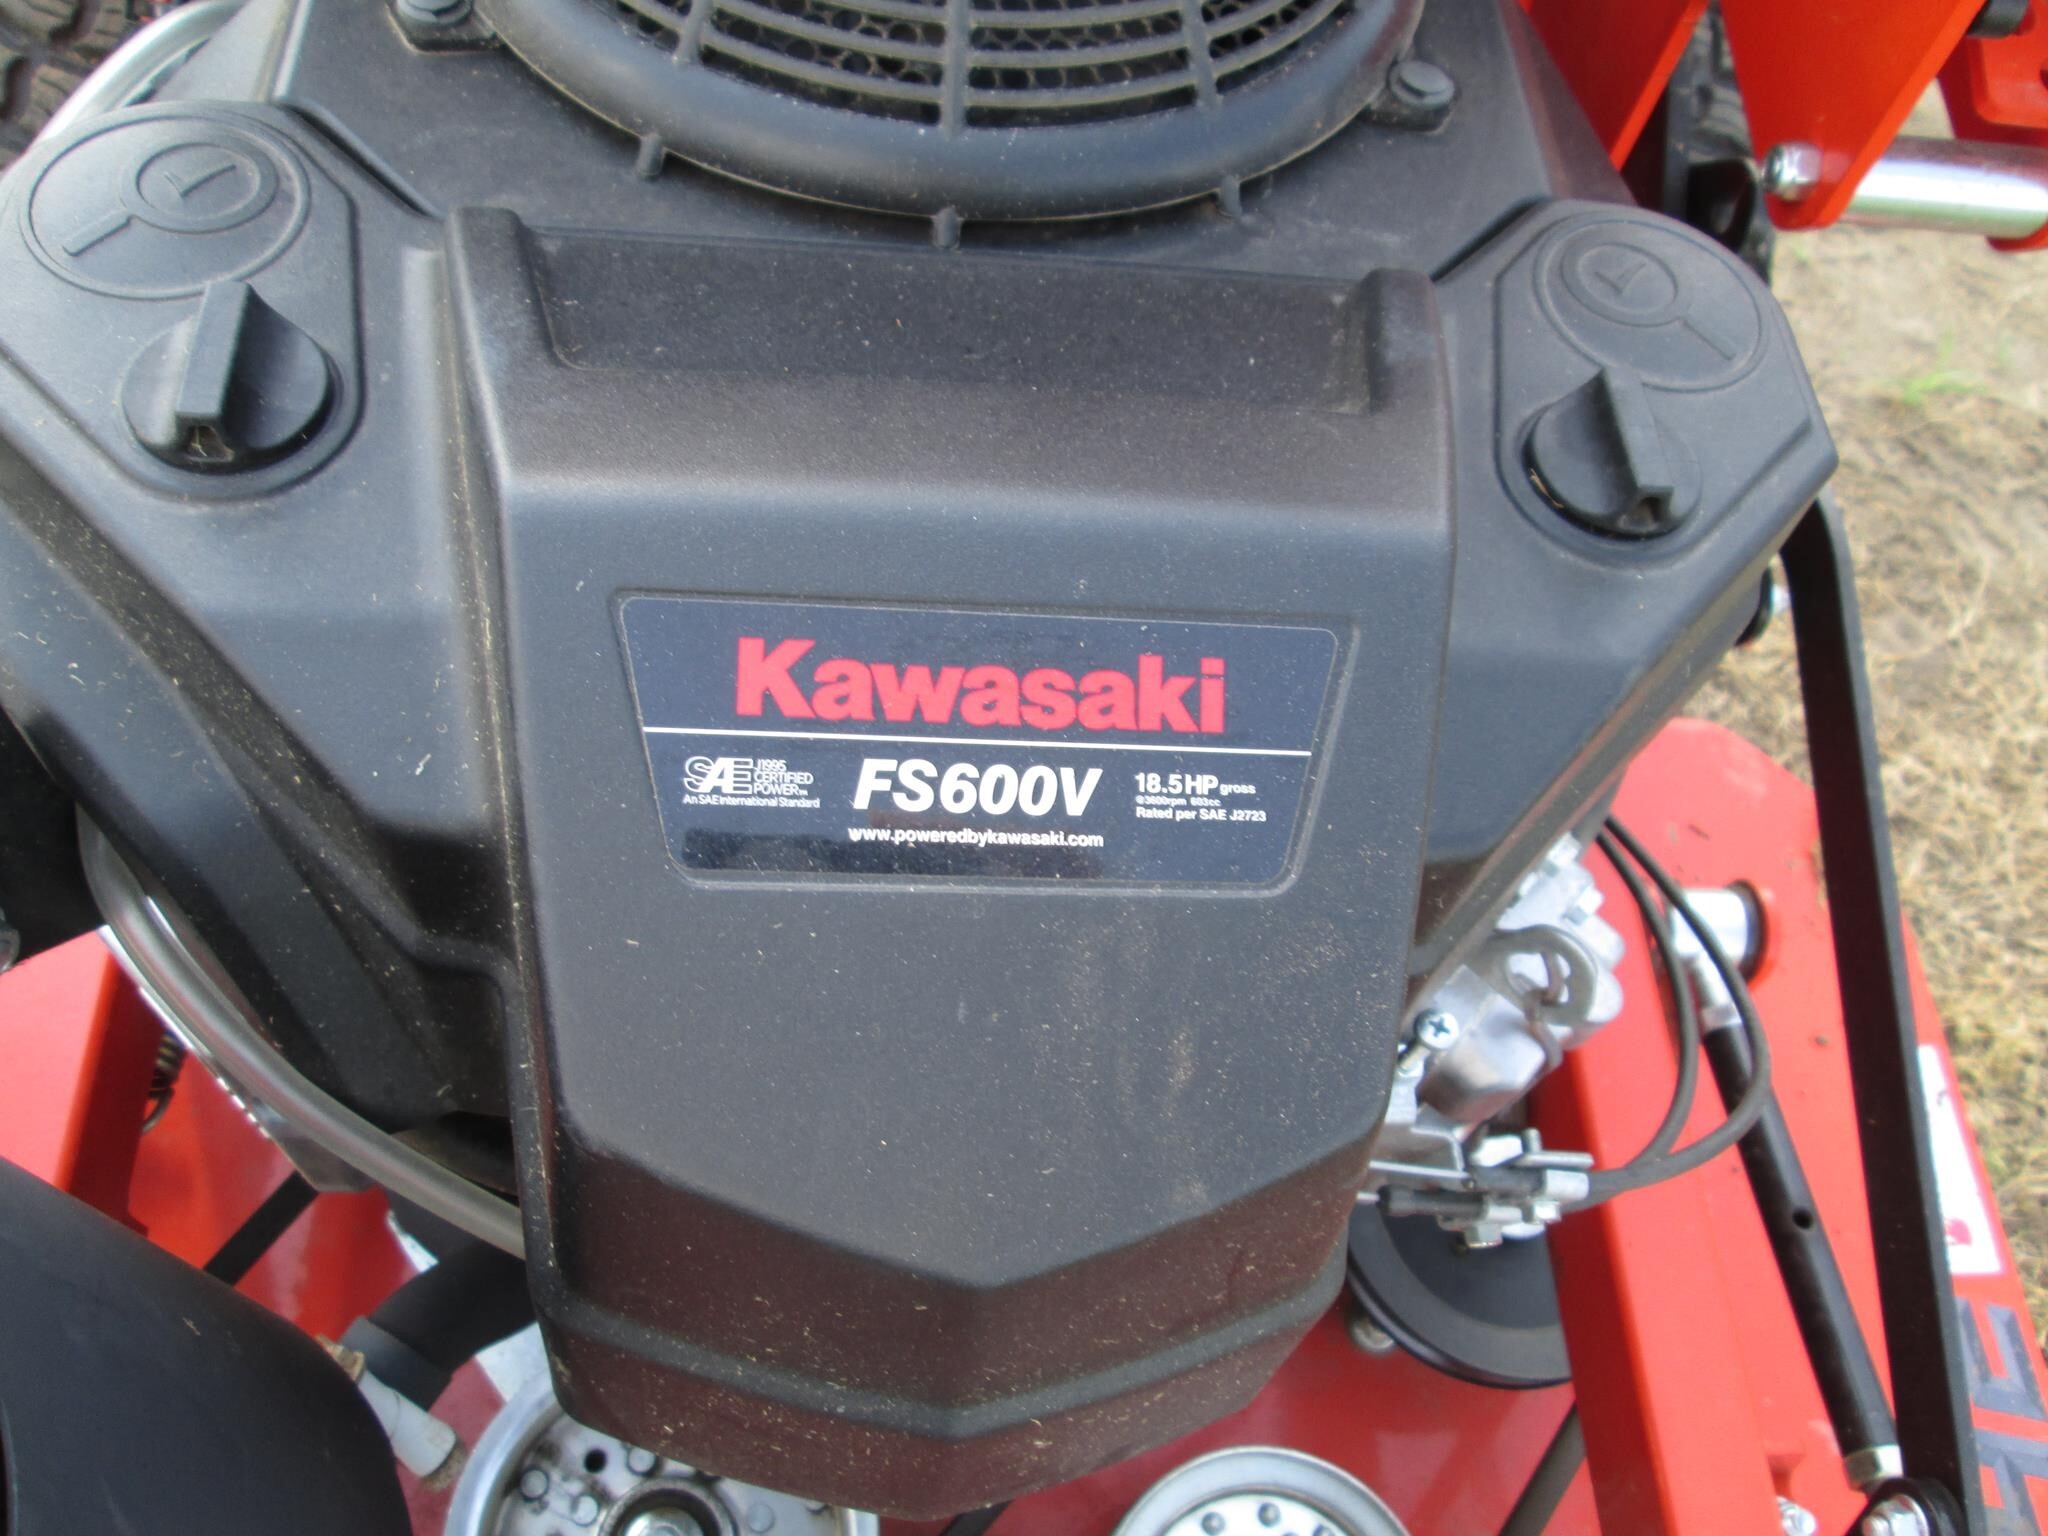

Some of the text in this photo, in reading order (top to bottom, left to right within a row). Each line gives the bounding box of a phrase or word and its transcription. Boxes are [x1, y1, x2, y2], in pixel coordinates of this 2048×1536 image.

[736, 636, 1225, 734] Kawasaki
[683, 756, 754, 794] SAE
[753, 771, 814, 785] CERTIFIED
[852, 757, 1104, 817] FS600V
[1219, 783, 1256, 796] gross
[699, 794, 720, 806] SAE
[720, 795, 778, 807] International
[778, 797, 820, 808] Standard
[1136, 806, 1267, 822] Rated per SAE J2723
[848, 826, 1104, 848] www.poweredbykawasaki.com
